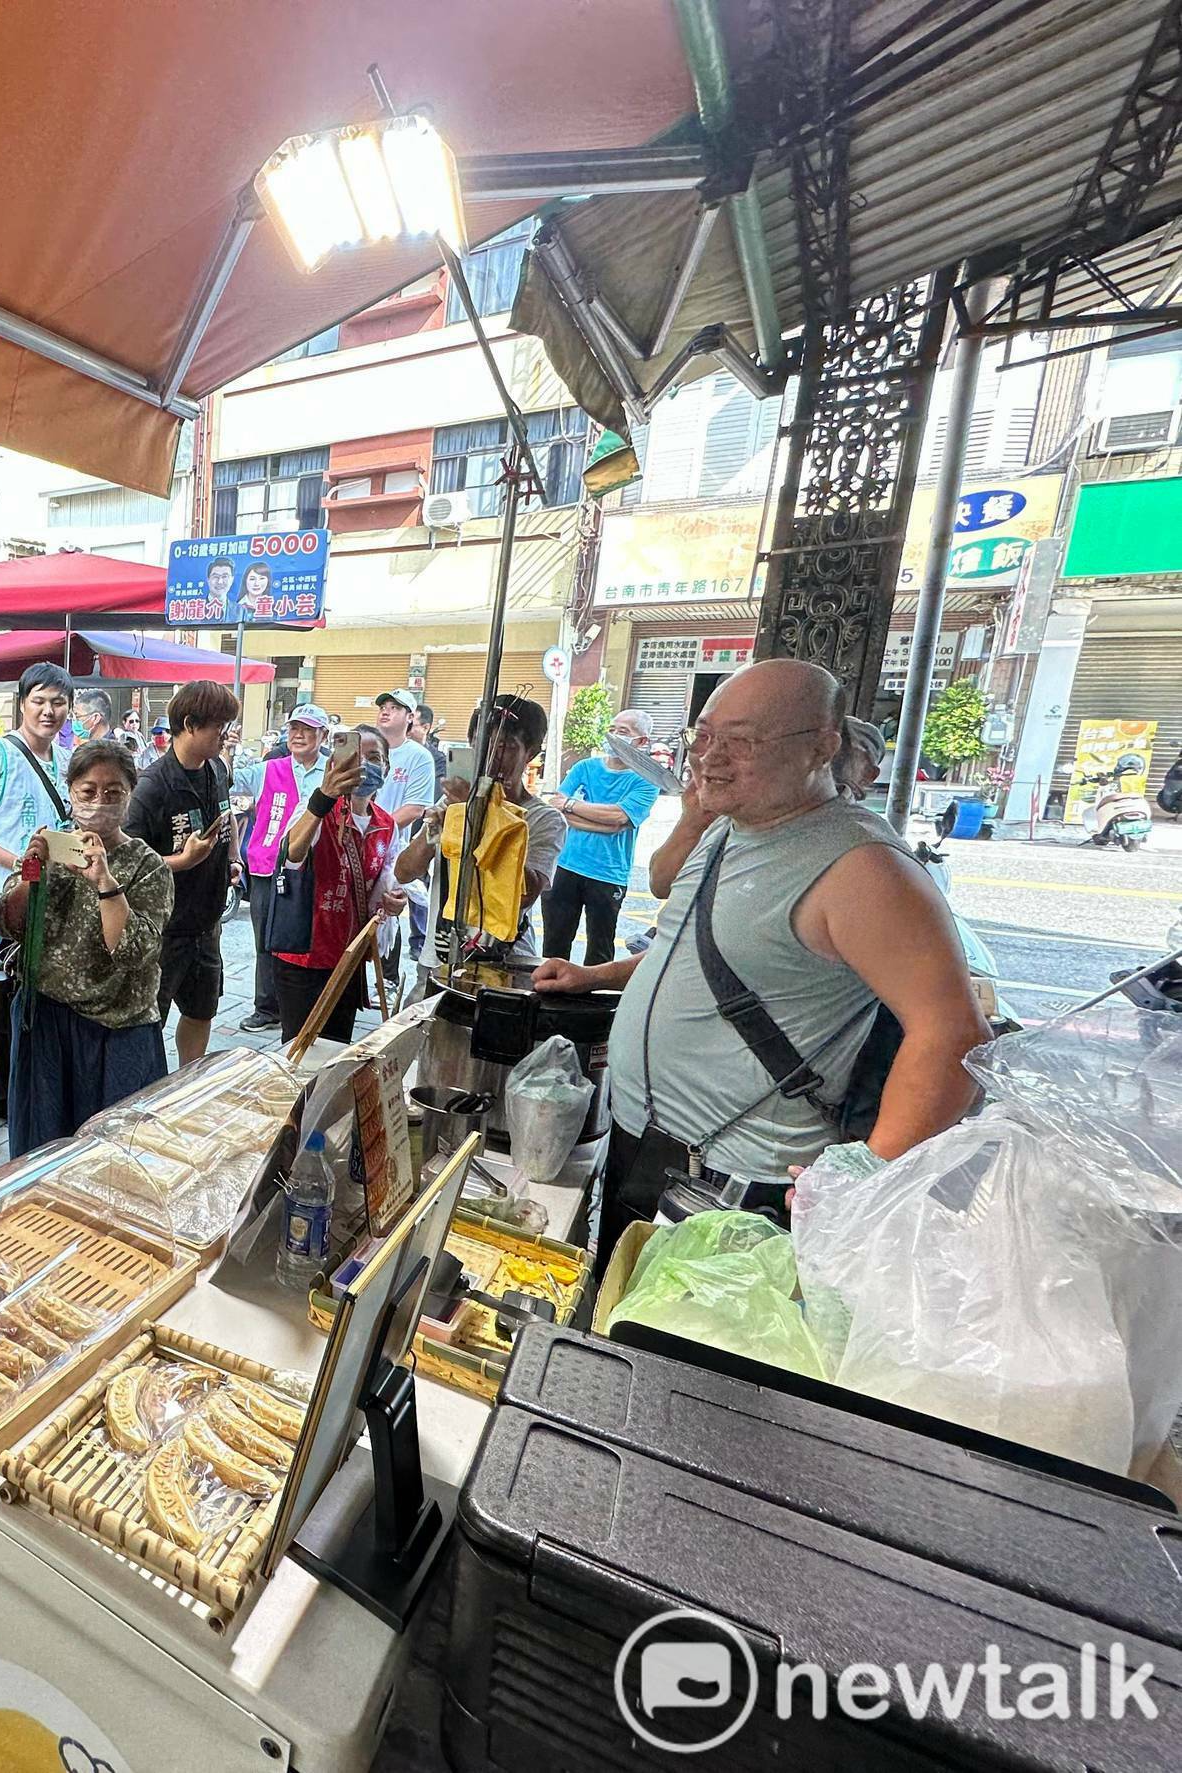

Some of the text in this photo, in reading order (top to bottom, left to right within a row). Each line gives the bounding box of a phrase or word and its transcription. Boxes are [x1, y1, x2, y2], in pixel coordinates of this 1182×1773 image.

[250, 533, 319, 557] 5000
[169, 598, 224, 621] 謝龍介
[254, 593, 316, 618] 童小芸
